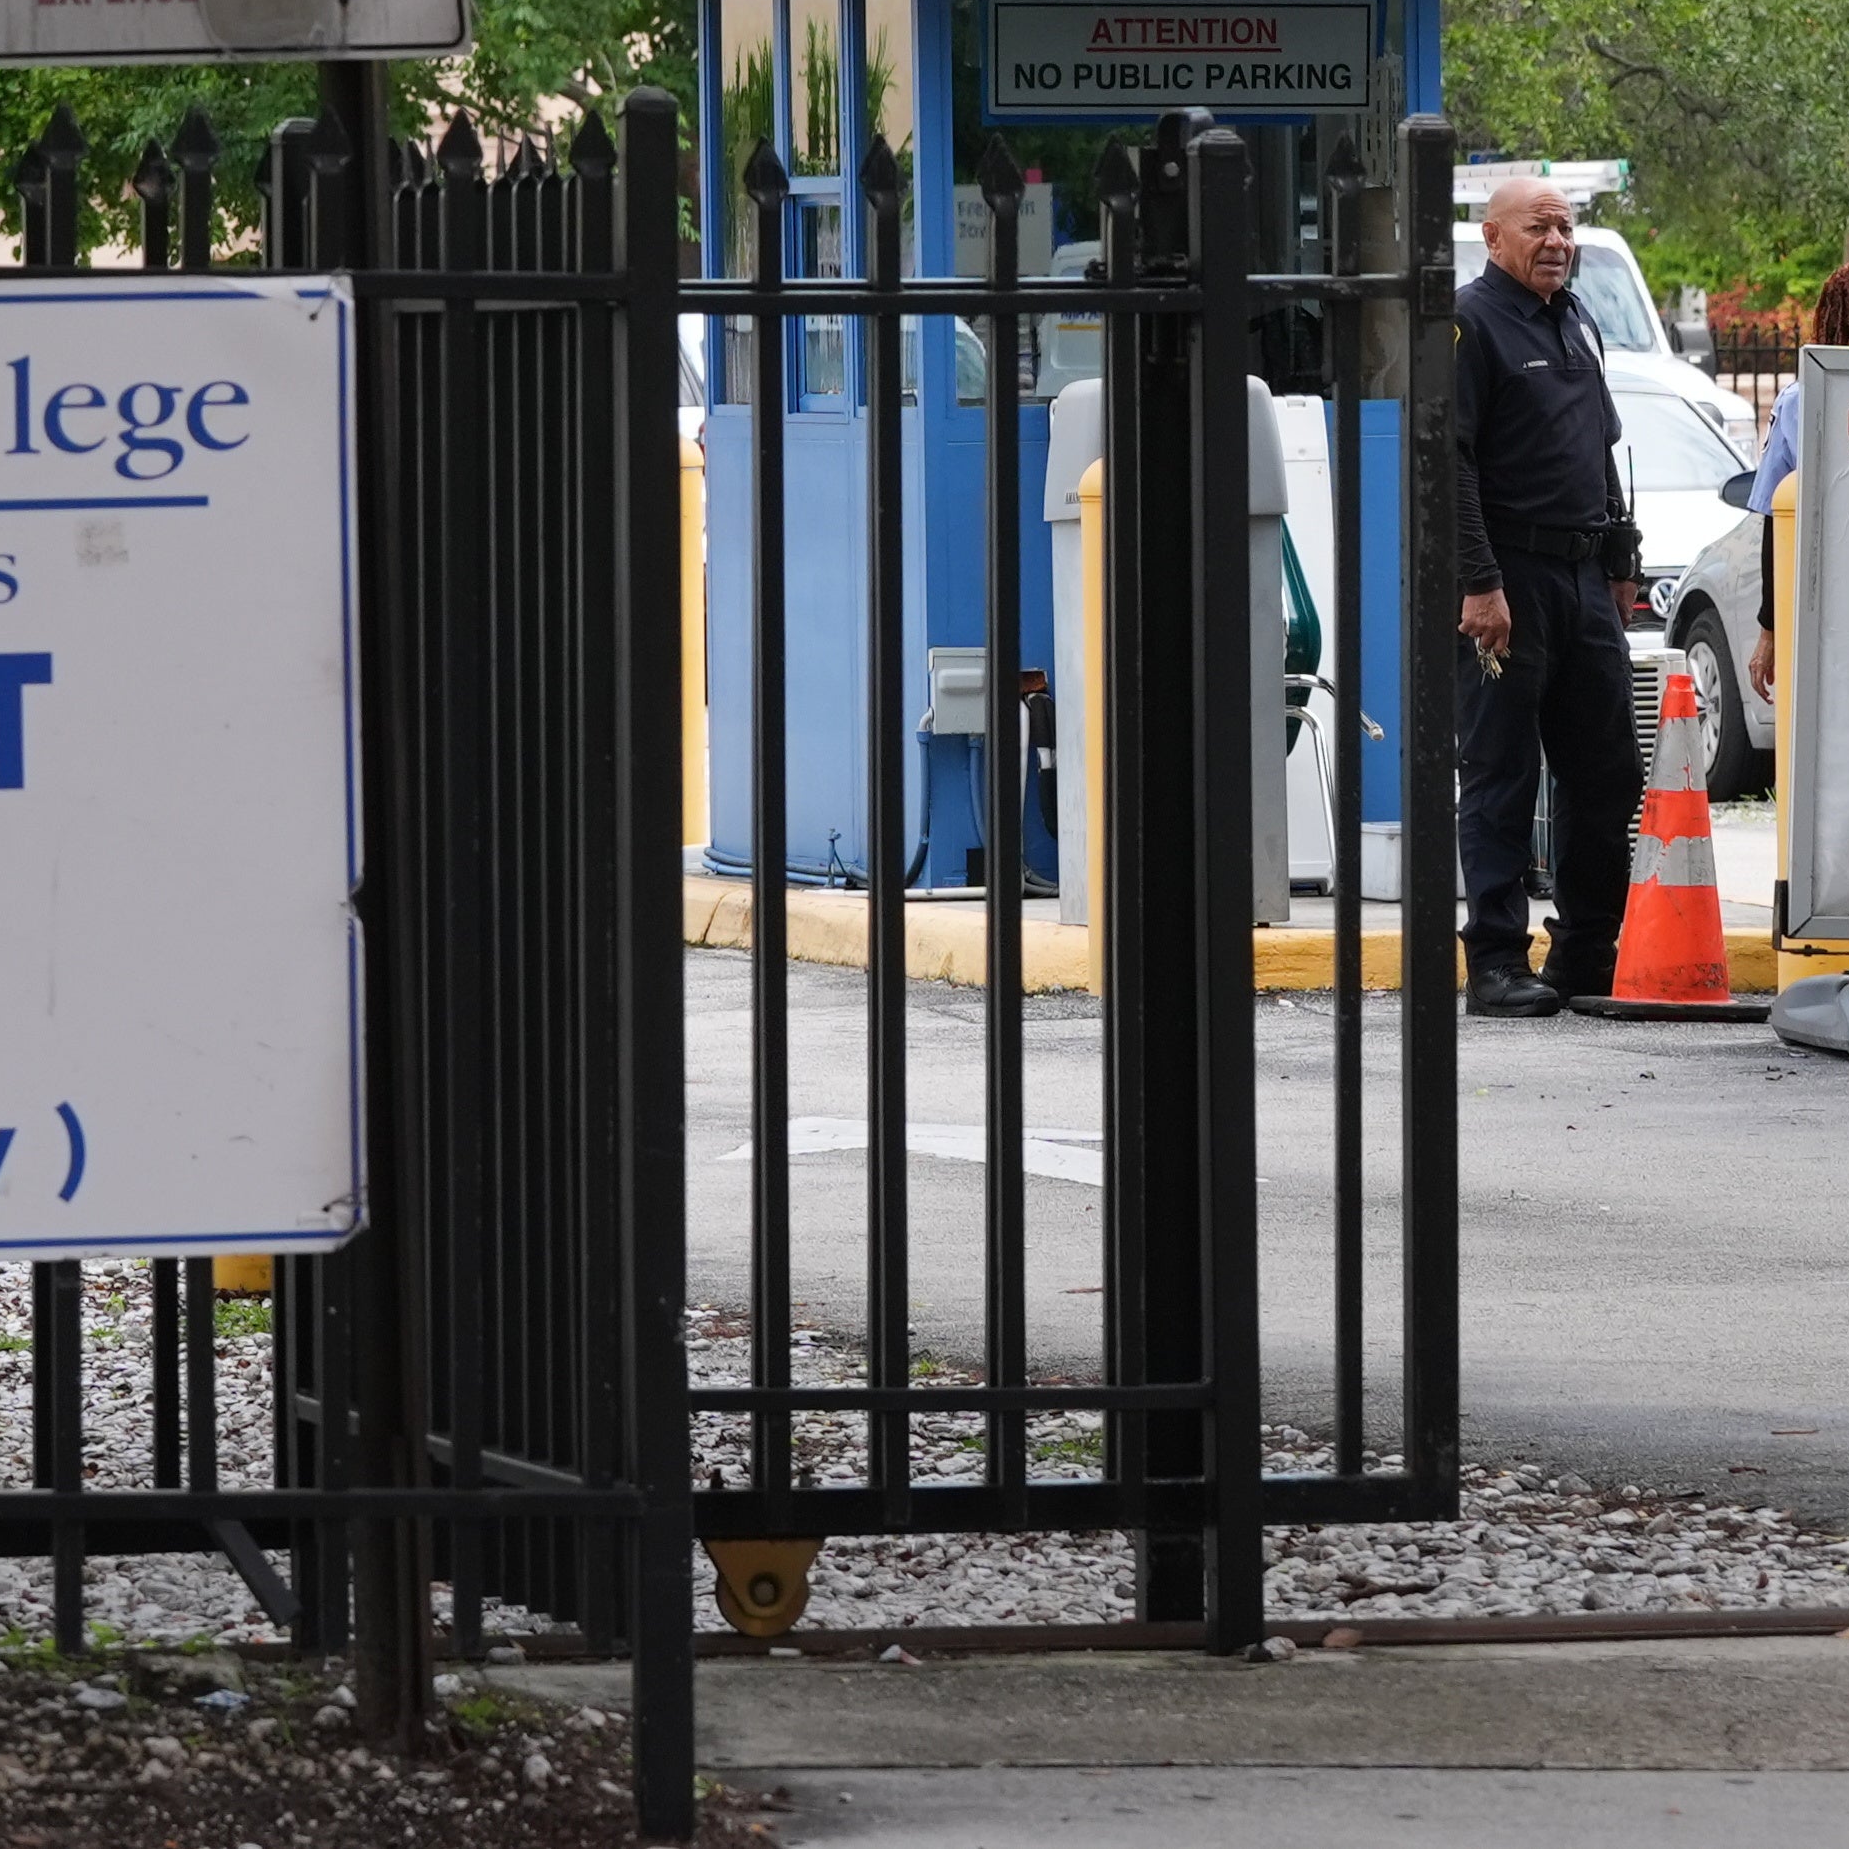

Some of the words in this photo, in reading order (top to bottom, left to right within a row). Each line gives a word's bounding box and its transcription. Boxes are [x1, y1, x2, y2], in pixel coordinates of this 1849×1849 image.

[1091, 18, 1277, 44] ATTENTION
[1014, 63, 1061, 90] NO
[1074, 63, 1194, 91] PUBLIC
[1206, 63, 1352, 91] PARKING
